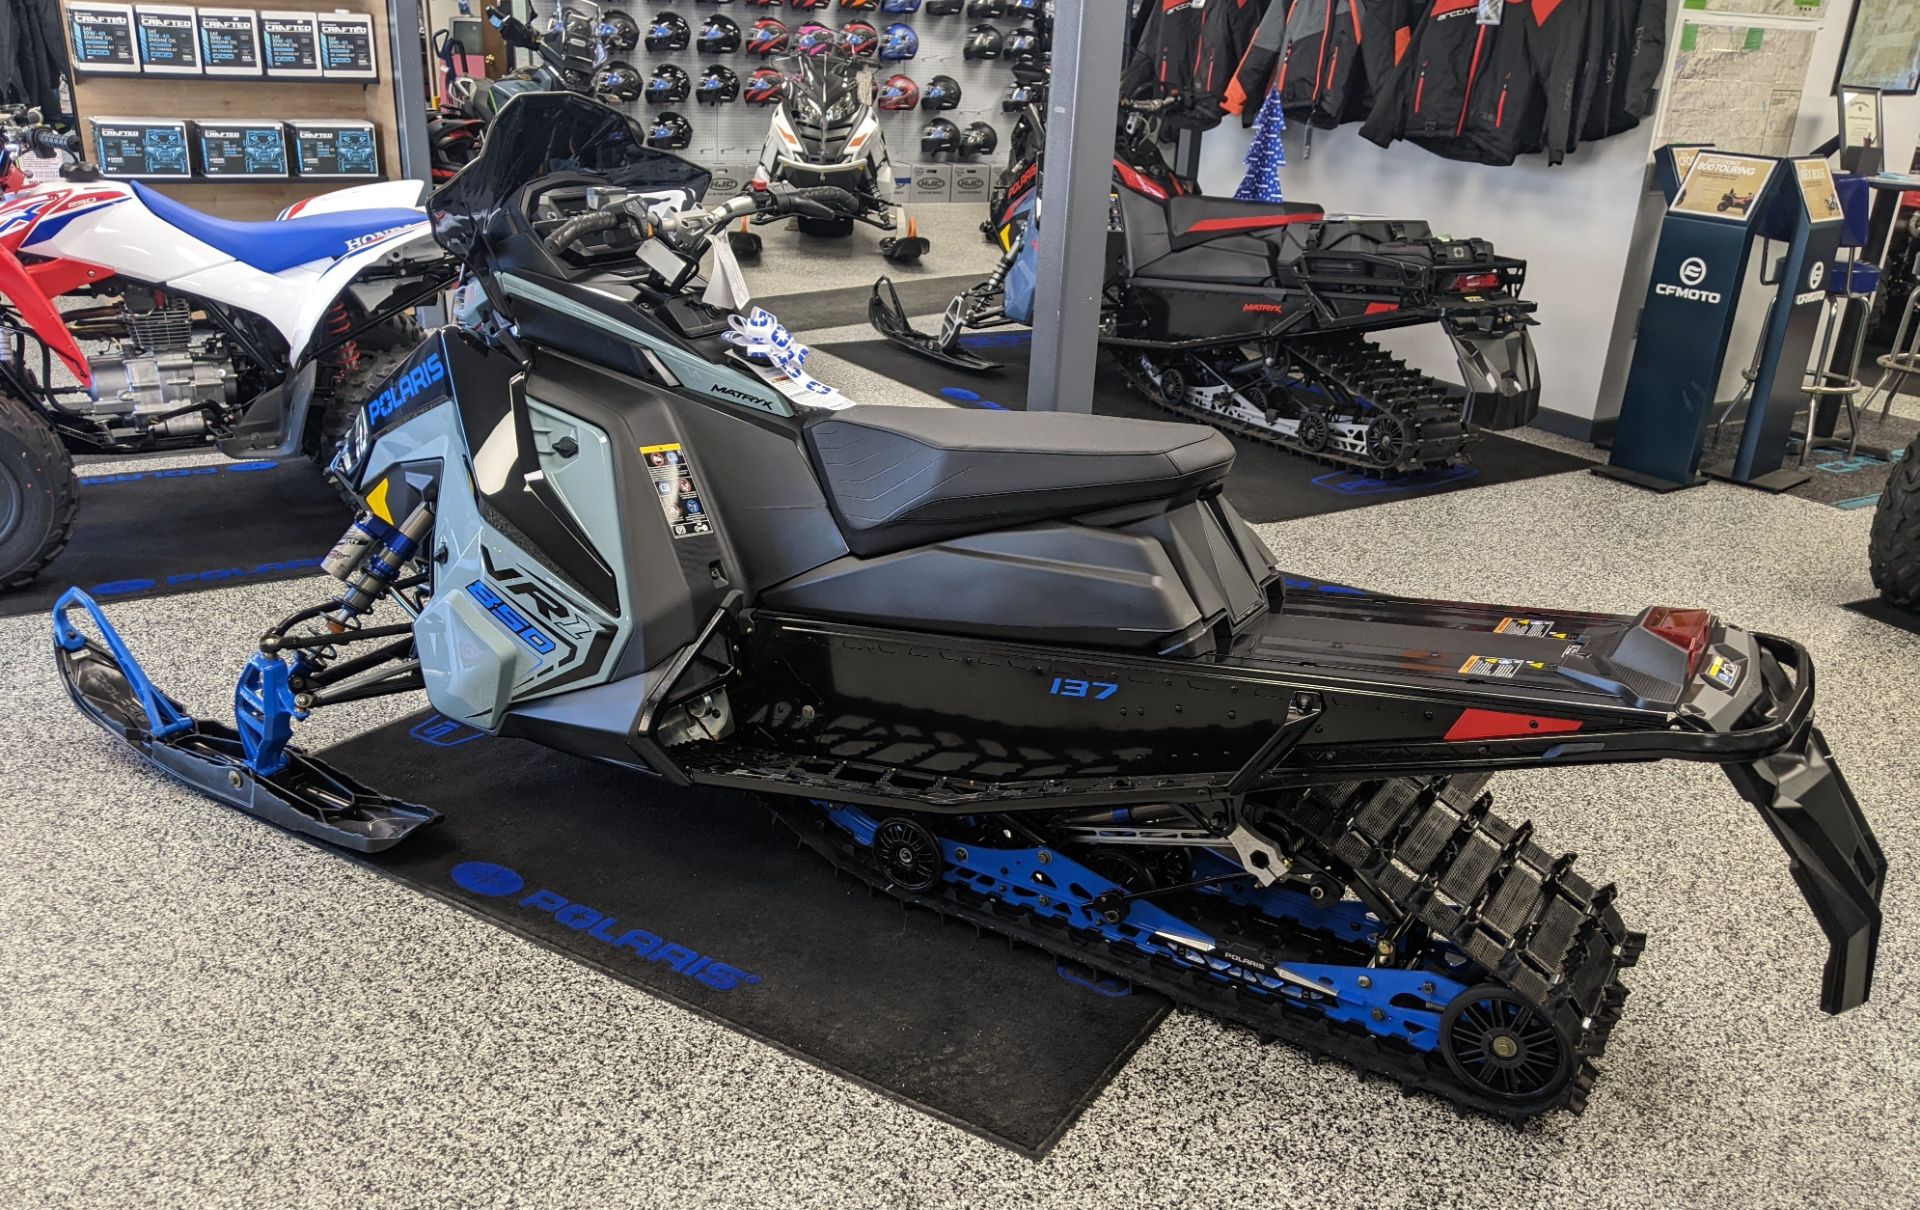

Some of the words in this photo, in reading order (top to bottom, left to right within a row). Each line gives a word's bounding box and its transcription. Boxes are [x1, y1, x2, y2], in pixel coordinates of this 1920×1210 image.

[75, 15, 127, 25] CRAFTED
[141, 19, 192, 28] CRAFTED
[203, 21, 251, 29] CRAFTED
[322, 26, 367, 34] CRAFTED
[1655, 283, 1721, 304] CFMOTO
[1242, 303, 1283, 314] MATRYX
[368, 352, 445, 425] POLARIS
[710, 383, 773, 410] MATRYX
[465, 579, 557, 655] 850
[1050, 677, 1120, 700] 137
[519, 888, 754, 991] POLARIS
[1224, 951, 1266, 970] POLARIS
